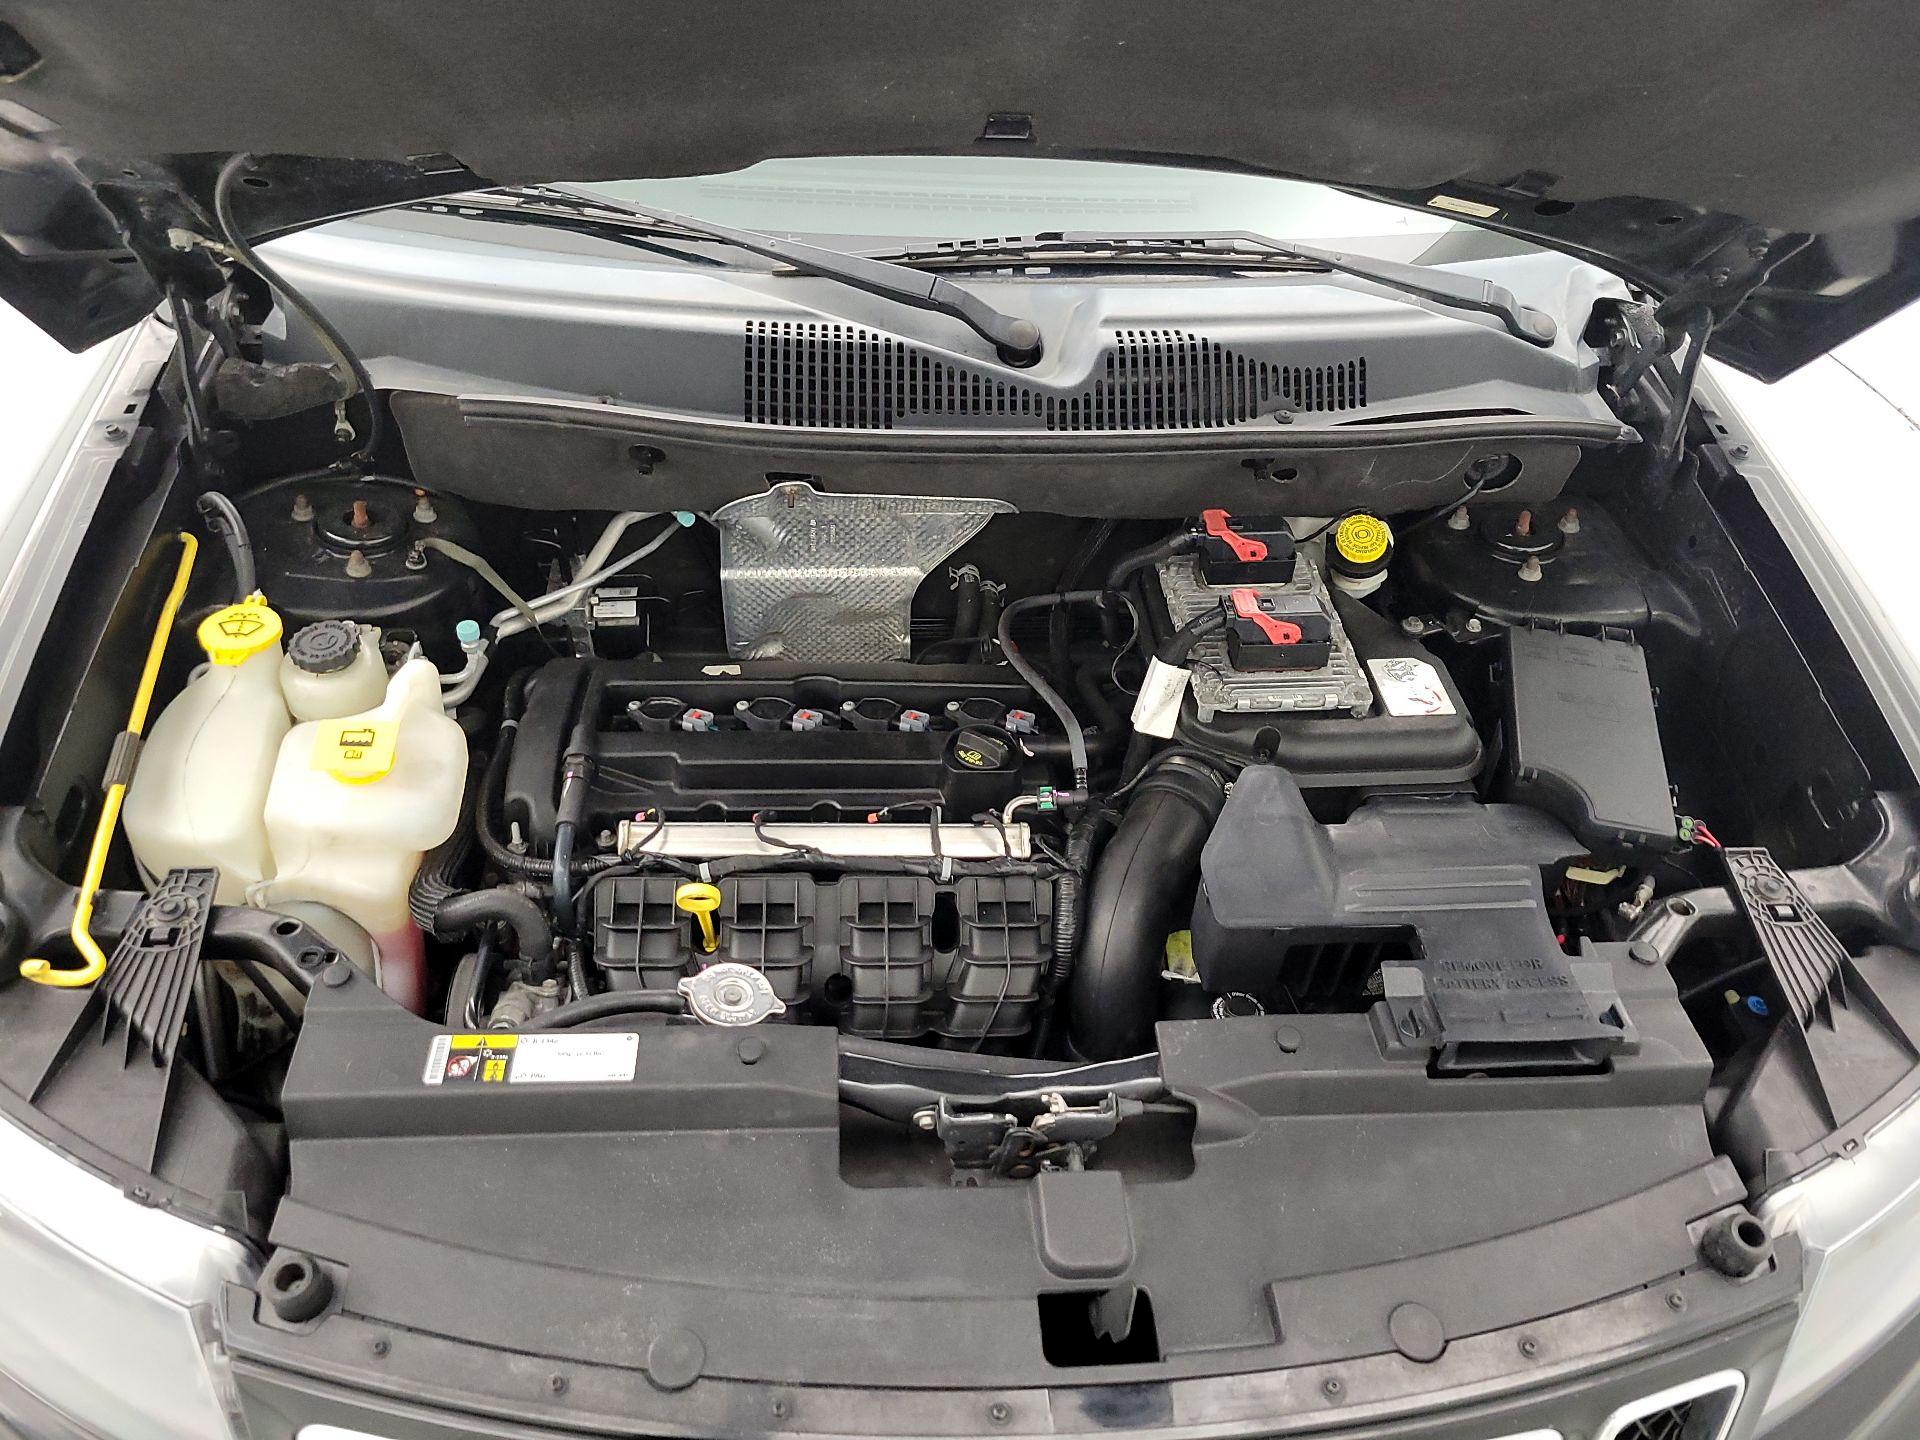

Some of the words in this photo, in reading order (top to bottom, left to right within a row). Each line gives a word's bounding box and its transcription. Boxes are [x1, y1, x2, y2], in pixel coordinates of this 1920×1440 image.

[1439, 960, 1502, 971] REMOVE
[1510, 959, 1543, 971] FOR
[1434, 976, 1501, 990] BATTERY
[1507, 975, 1569, 989] ACCESS
